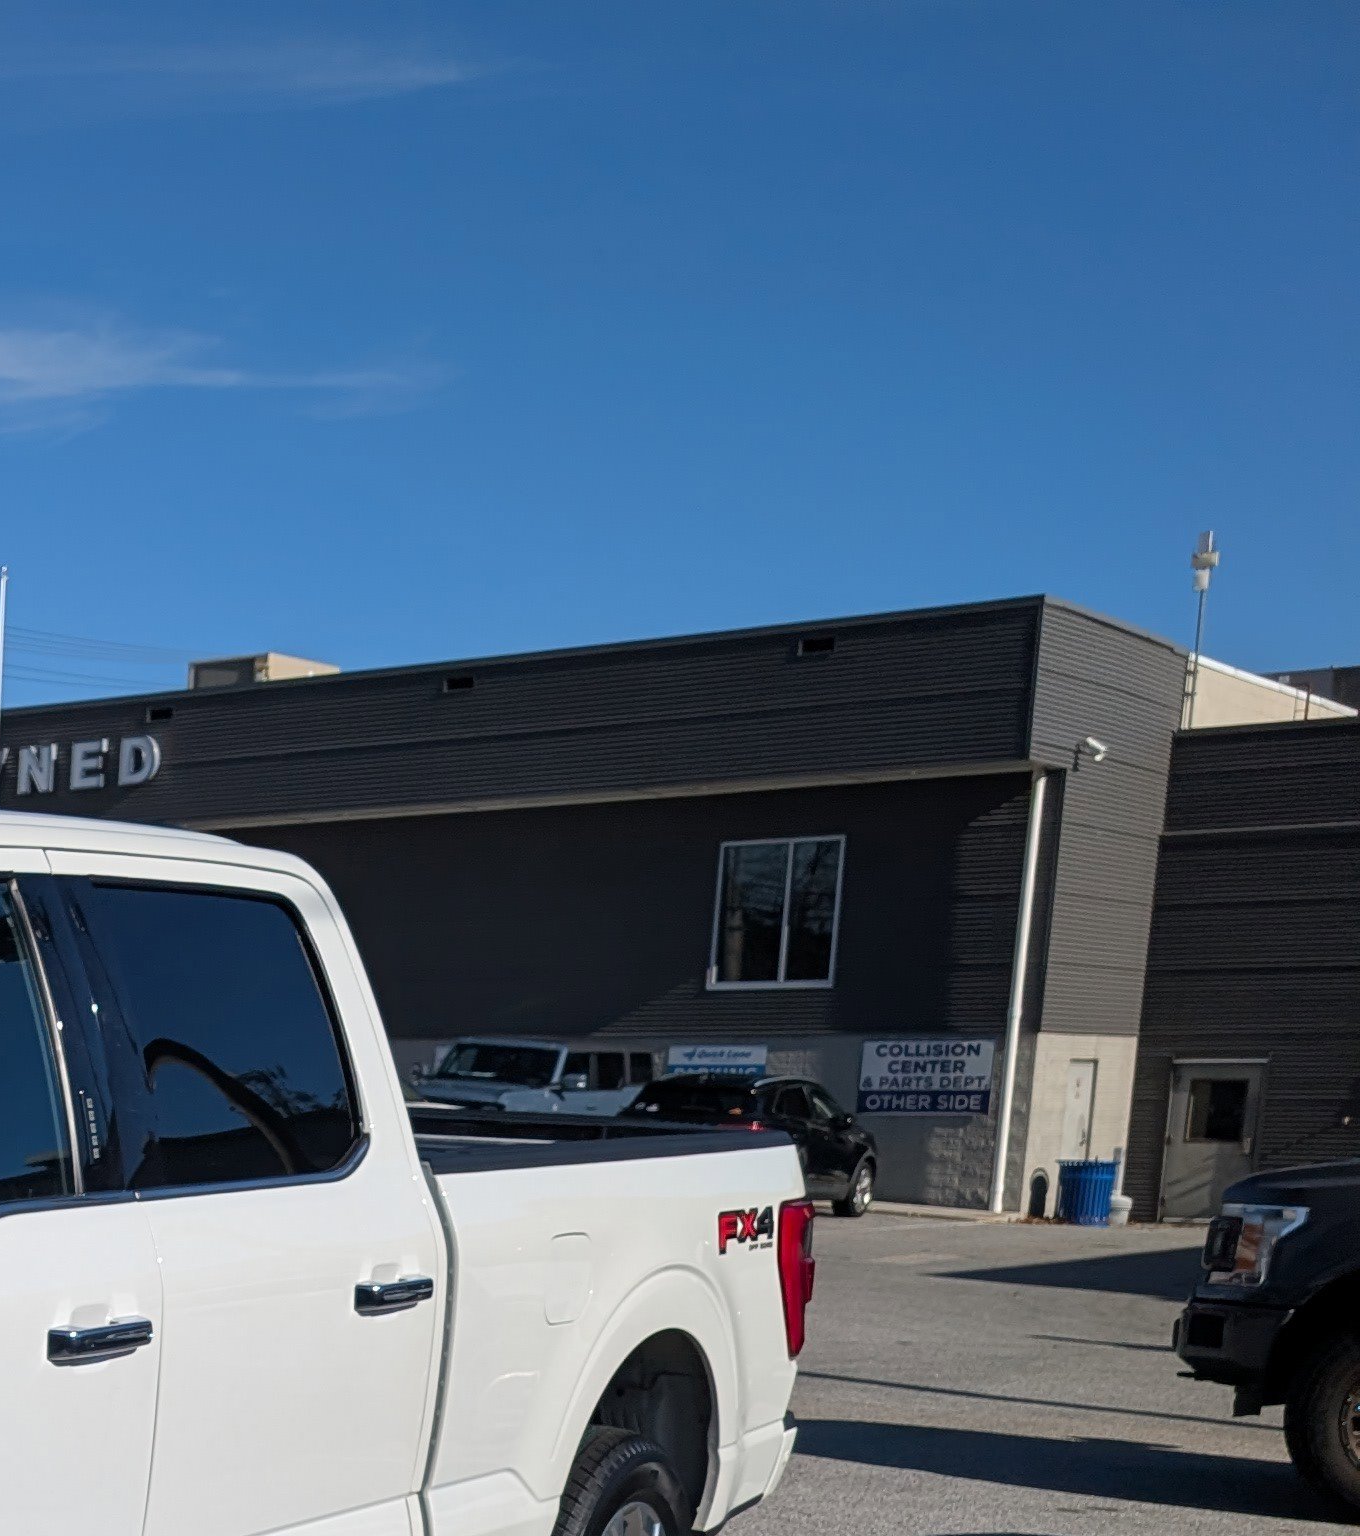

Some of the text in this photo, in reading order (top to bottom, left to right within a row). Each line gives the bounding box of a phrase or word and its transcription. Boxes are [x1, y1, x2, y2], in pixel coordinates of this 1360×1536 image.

[875, 1044, 981, 1058] COLLISION
[887, 1060, 966, 1074] CENTER
[862, 1075, 873, 1088] &
[879, 1075, 933, 1089] PARTS
[865, 1094, 982, 1110] OTHER SIDE
[718, 1205, 775, 1256] FX4
